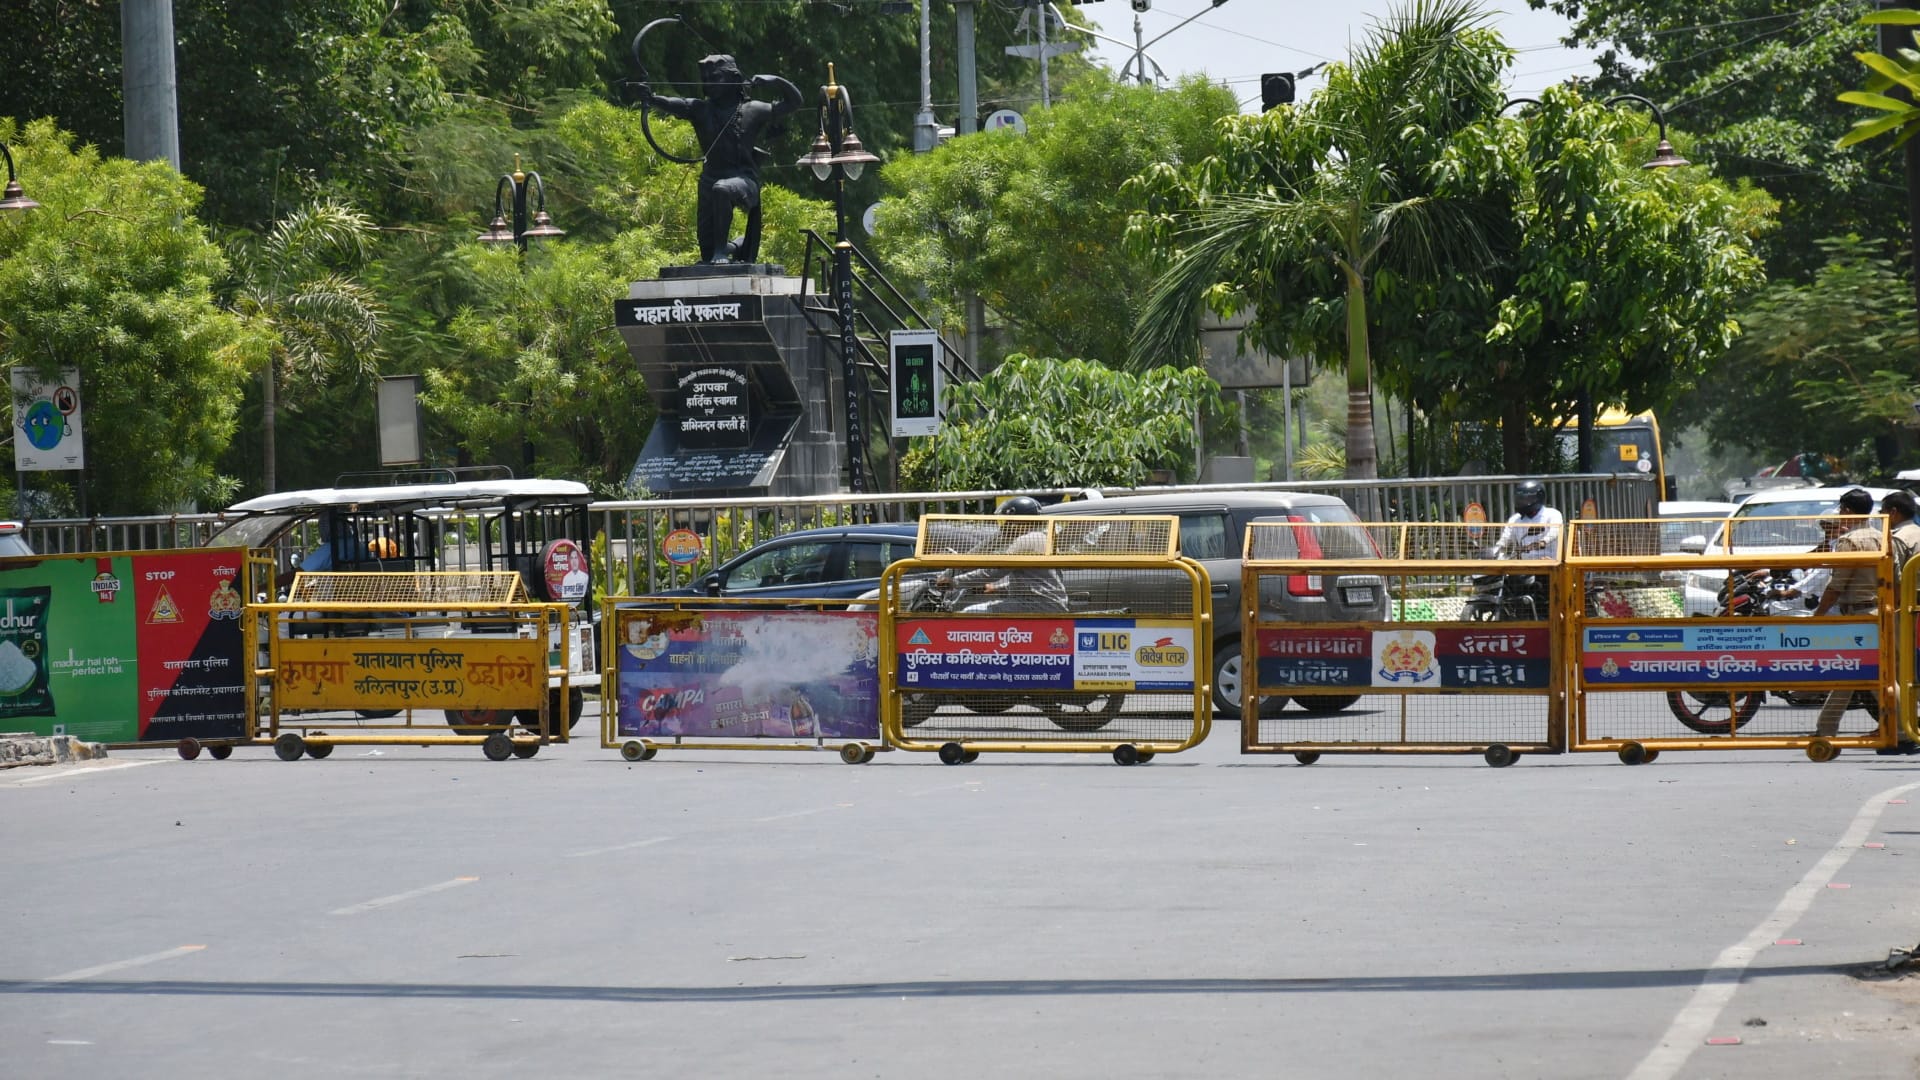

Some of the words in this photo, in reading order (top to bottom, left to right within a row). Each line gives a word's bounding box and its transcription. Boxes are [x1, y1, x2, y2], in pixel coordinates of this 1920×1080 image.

[634, 305, 671, 325] महान
[672, 299, 692, 322] वीर
[693, 303, 741, 322] एकलव्य
[842, 280, 855, 376] PRAYAGRAJ
[693, 383, 728, 392] आपका
[686, 394, 712, 408] हार्दिक
[713, 396, 738, 406] स्वागत
[681, 418, 716, 432] अभिनन्दन
[717, 416, 738, 430] करती
[848, 391, 859, 442] NAGAR
[145, 571, 176, 580] STOP
[947, 631, 995, 643] यातायात
[998, 628, 1032, 648] पुलिस
[1102, 634, 1127, 650] LIC
[1269, 637, 1363, 654] यातायात
[1458, 634, 1527, 655] उत्तर
[52, 648, 84, 668] madhur
[88, 658, 101, 666] hai
[104, 657, 118, 665] toh
[163, 660, 200, 670] यातायात
[202, 656, 229, 672] पुलिस
[353, 653, 417, 670] यातायात
[418, 648, 464, 673] पुलिस
[905, 648, 942, 670] पुलिस
[946, 648, 1008, 666] कमिश्नरेट
[1011, 654, 1070, 668] प्रयागराज
[1140, 648, 1163, 664] निवेश
[1166, 652, 1184, 664] प्लस
[72, 666, 104, 678] perfect
[1280, 660, 1348, 686] पुलिस
[1456, 660, 1526, 685] प्रदेश
[1629, 660, 1701, 674] यातायात
[1706, 655, 1762, 680] पुलिस,
[1769, 658, 1814, 672] उत्तर
[1818, 654, 1862, 674] प्रदेश
[147, 688, 170, 701] पुलिस
